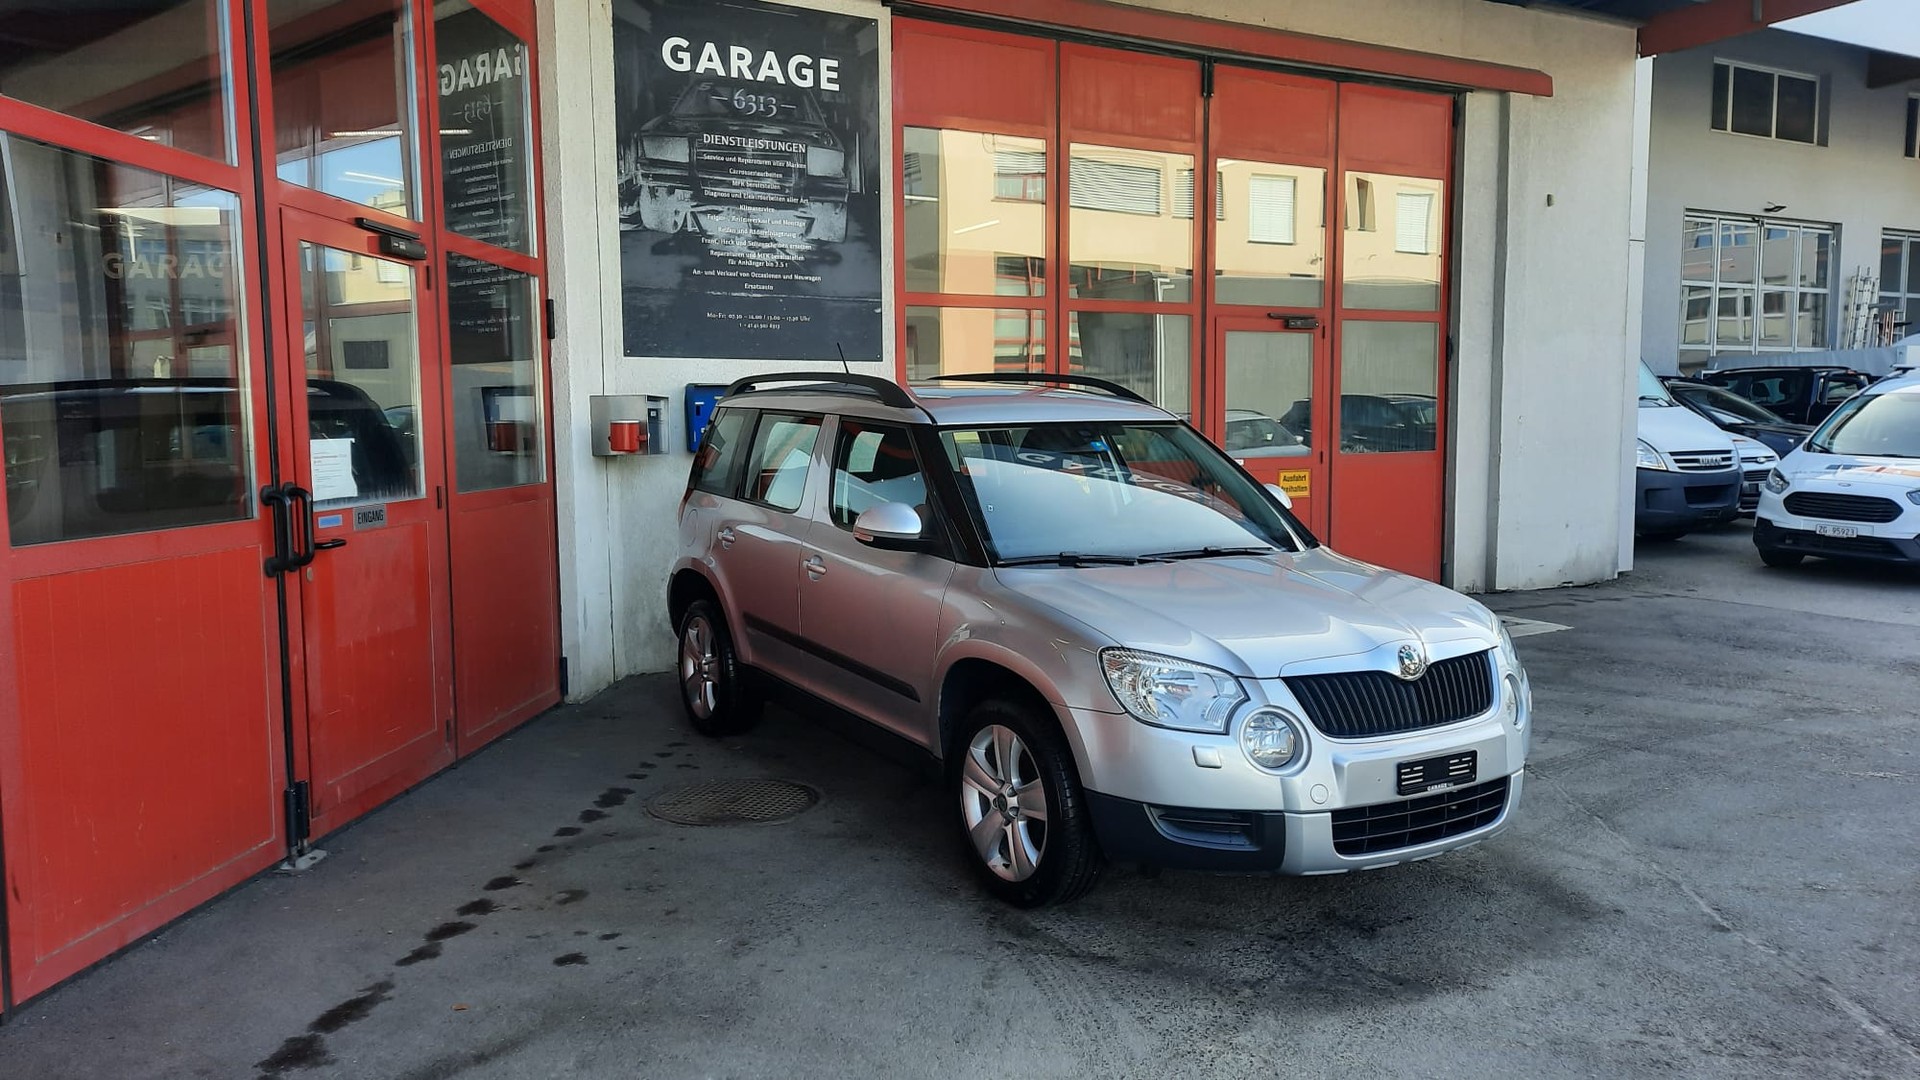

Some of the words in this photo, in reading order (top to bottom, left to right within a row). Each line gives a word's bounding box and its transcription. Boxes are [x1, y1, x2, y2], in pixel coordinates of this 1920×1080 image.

[661, 35, 840, 91] GARAGE
[733, 88, 777, 117] 6313
[703, 133, 806, 153] DIENSTLEISTUNGEN
[703, 153, 724, 161] Service
[738, 156, 771, 166] Reparaturen
[786, 160, 807, 168] Marken
[732, 179, 745, 187] MFK
[746, 181, 781, 189] bereitstellen
[704, 190, 730, 198] Diagnose
[743, 193, 785, 202] Elektroarbeiten
[799, 196, 809, 204] Art
[739, 204, 775, 213] Klimaservice
[709, 250, 745, 259] Reparaturen
[738, 259, 764, 267] Anhänger
[750, 271, 782, 279] Occasionen
[794, 274, 822, 282] Neuwagen
[1283, 474, 1307, 482] Ausfahrt
[357, 509, 384, 525] EINGANG
[1818, 525, 1828, 534] ZG
